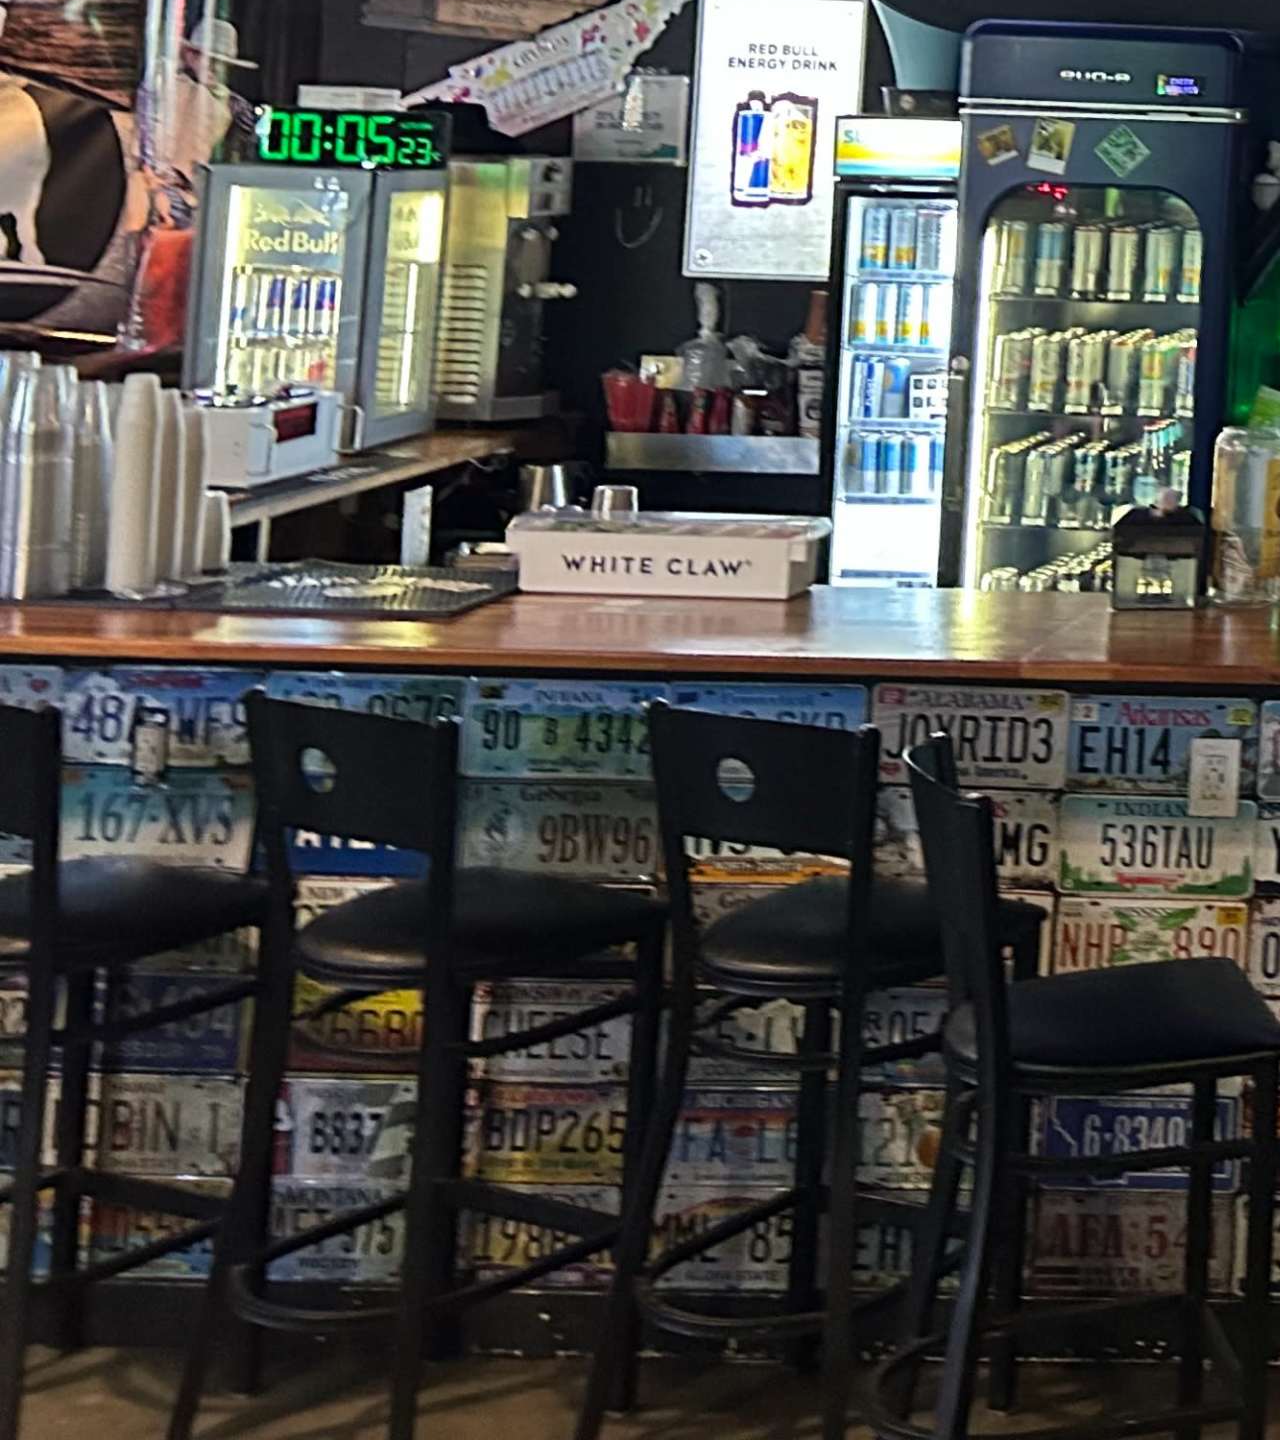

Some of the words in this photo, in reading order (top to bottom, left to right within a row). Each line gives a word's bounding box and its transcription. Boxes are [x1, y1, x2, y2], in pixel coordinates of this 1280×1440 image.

[749, 43, 778, 54] RED
[782, 45, 819, 57] BULL
[728, 57, 786, 69] ENERGY
[792, 59, 838, 71] DRINK
[561, 553, 653, 574] WHITE
[667, 558, 743, 576] CLAW
[536, 813, 654, 864] 9BW96
[1099, 822, 1216, 870] 536TAU
